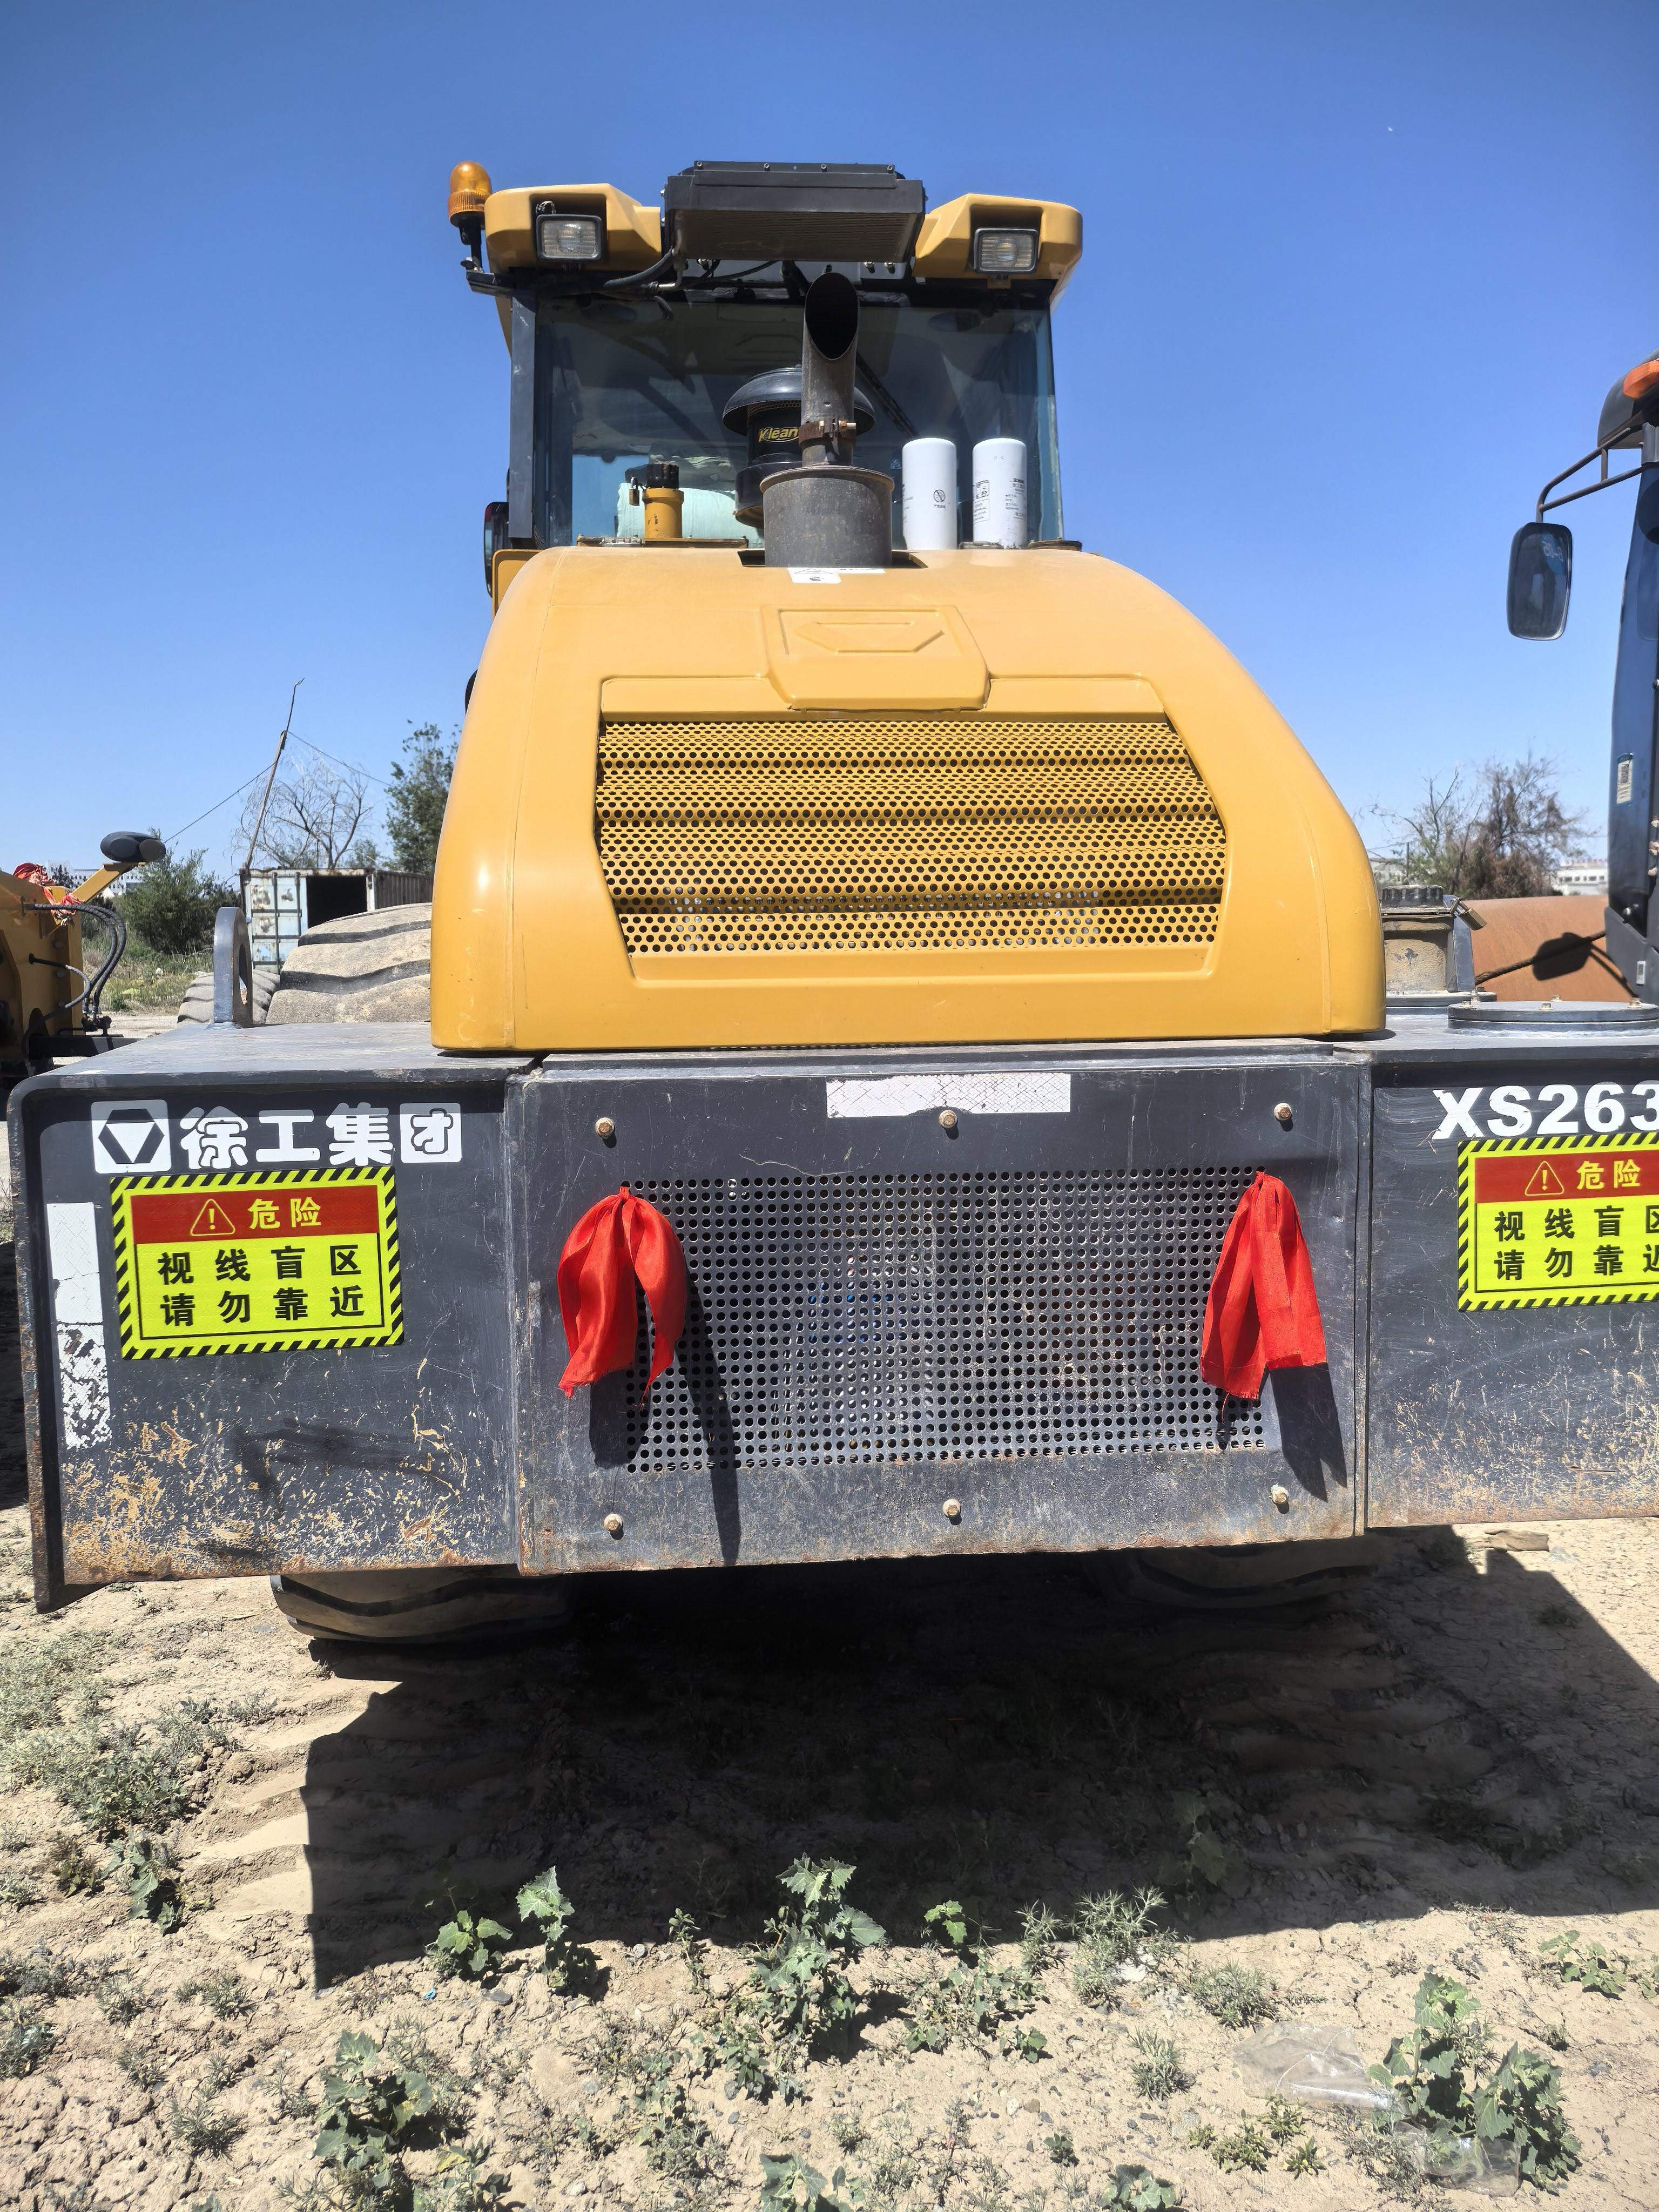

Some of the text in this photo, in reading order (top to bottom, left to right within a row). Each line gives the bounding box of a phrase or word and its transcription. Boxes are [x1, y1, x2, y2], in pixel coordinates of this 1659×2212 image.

[1432, 1080, 1659, 1139] XS263
[180, 1102, 463, 1169] 徐工集团
[1576, 1159, 1641, 1190] 危险
[247, 1197, 322, 1230] 危险
[157, 1244, 362, 1285] 视线盲区
[159, 1286, 365, 1327] 请勿靠近
